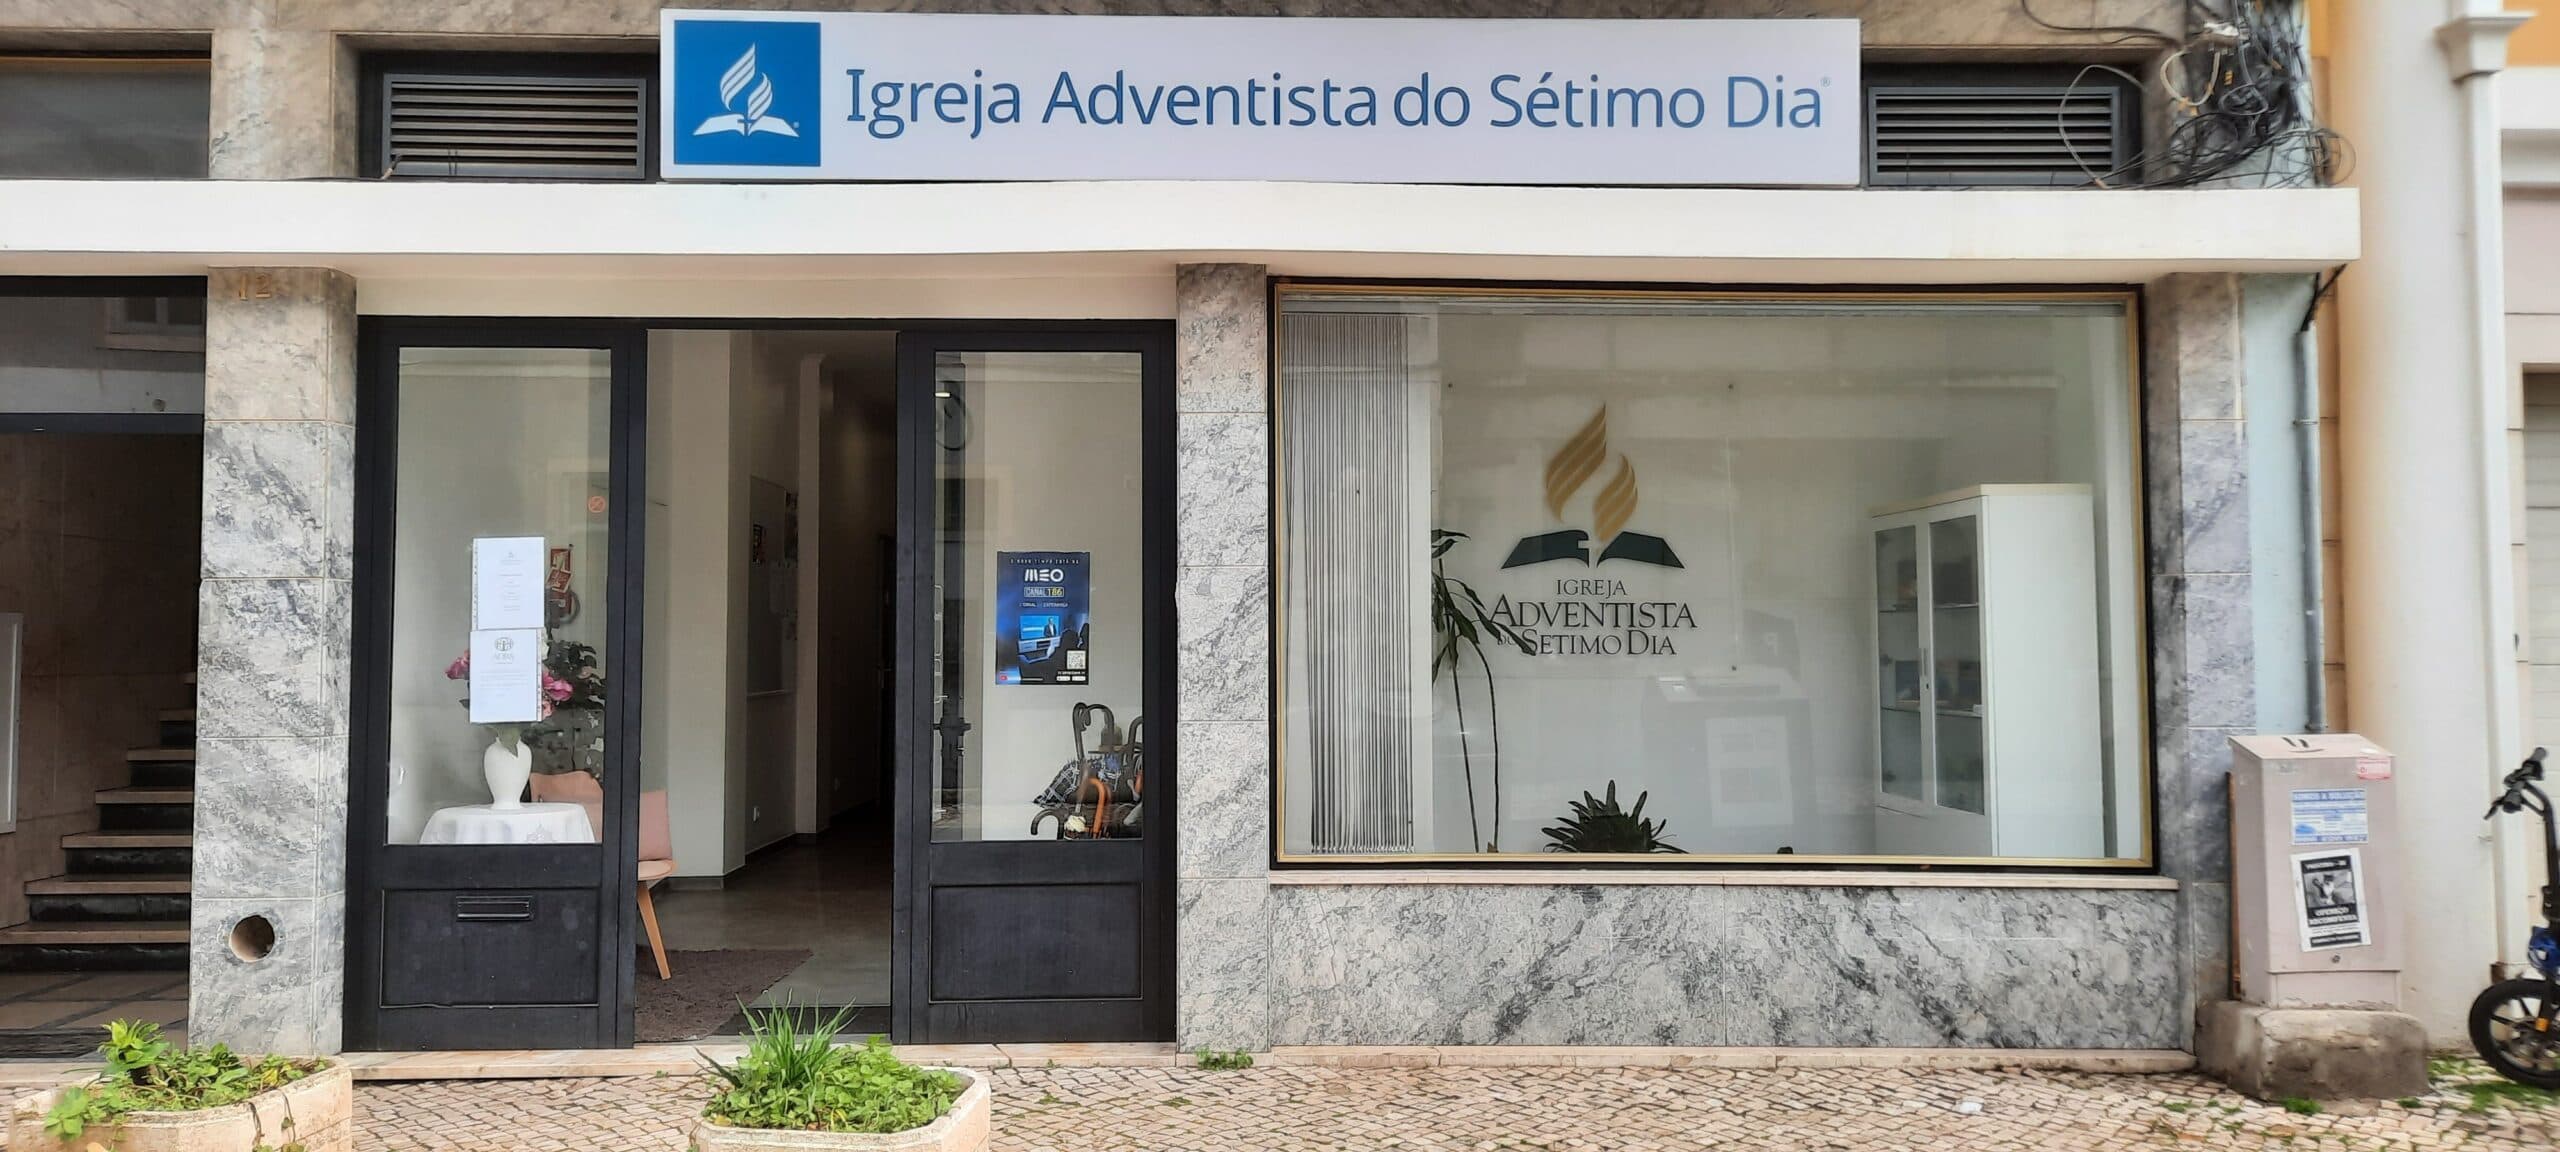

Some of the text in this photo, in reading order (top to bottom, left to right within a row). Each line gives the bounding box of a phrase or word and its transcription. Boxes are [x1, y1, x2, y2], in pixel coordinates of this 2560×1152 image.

[846, 68, 1821, 140] Igreja Adventista do Sétimo Dia
[1024, 568, 1064, 582] MEO
[1025, 587, 1063, 597] CANAL 186
[1556, 579, 1627, 600] IGREJA
[1490, 593, 1698, 628] ADVENTISTA
[1627, 629, 1677, 655] DIA
